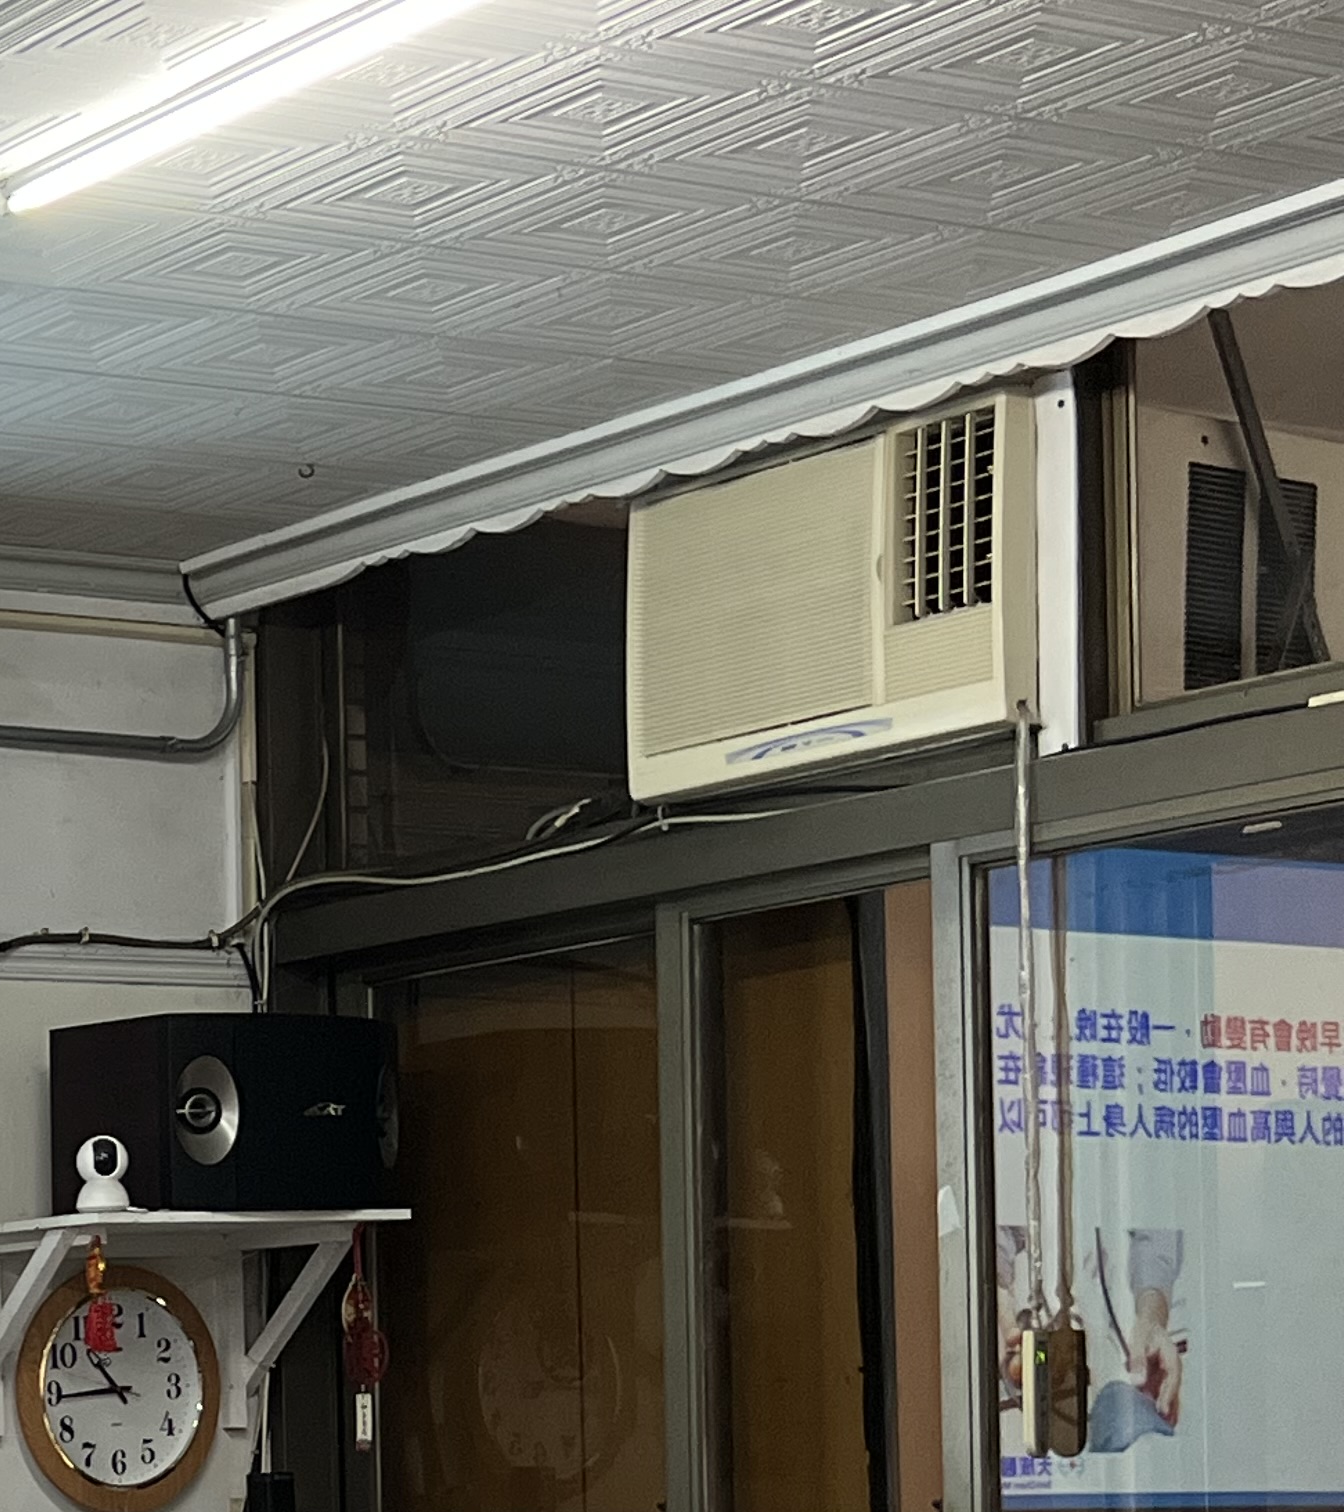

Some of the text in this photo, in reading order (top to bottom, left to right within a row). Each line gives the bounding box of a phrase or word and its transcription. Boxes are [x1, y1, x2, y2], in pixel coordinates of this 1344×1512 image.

[137, 1312, 146, 1338] 1
[51, 1342, 77, 1369] 10
[156, 1338, 171, 1363] 2
[47, 1380, 62, 1406] 9
[166, 1373, 181, 1399] 3
[59, 1415, 74, 1443] 8
[159, 1410, 175, 1437] 4
[82, 1441, 96, 1467] 7
[112, 1449, 126, 1475] 6
[140, 1439, 155, 1464] 5
